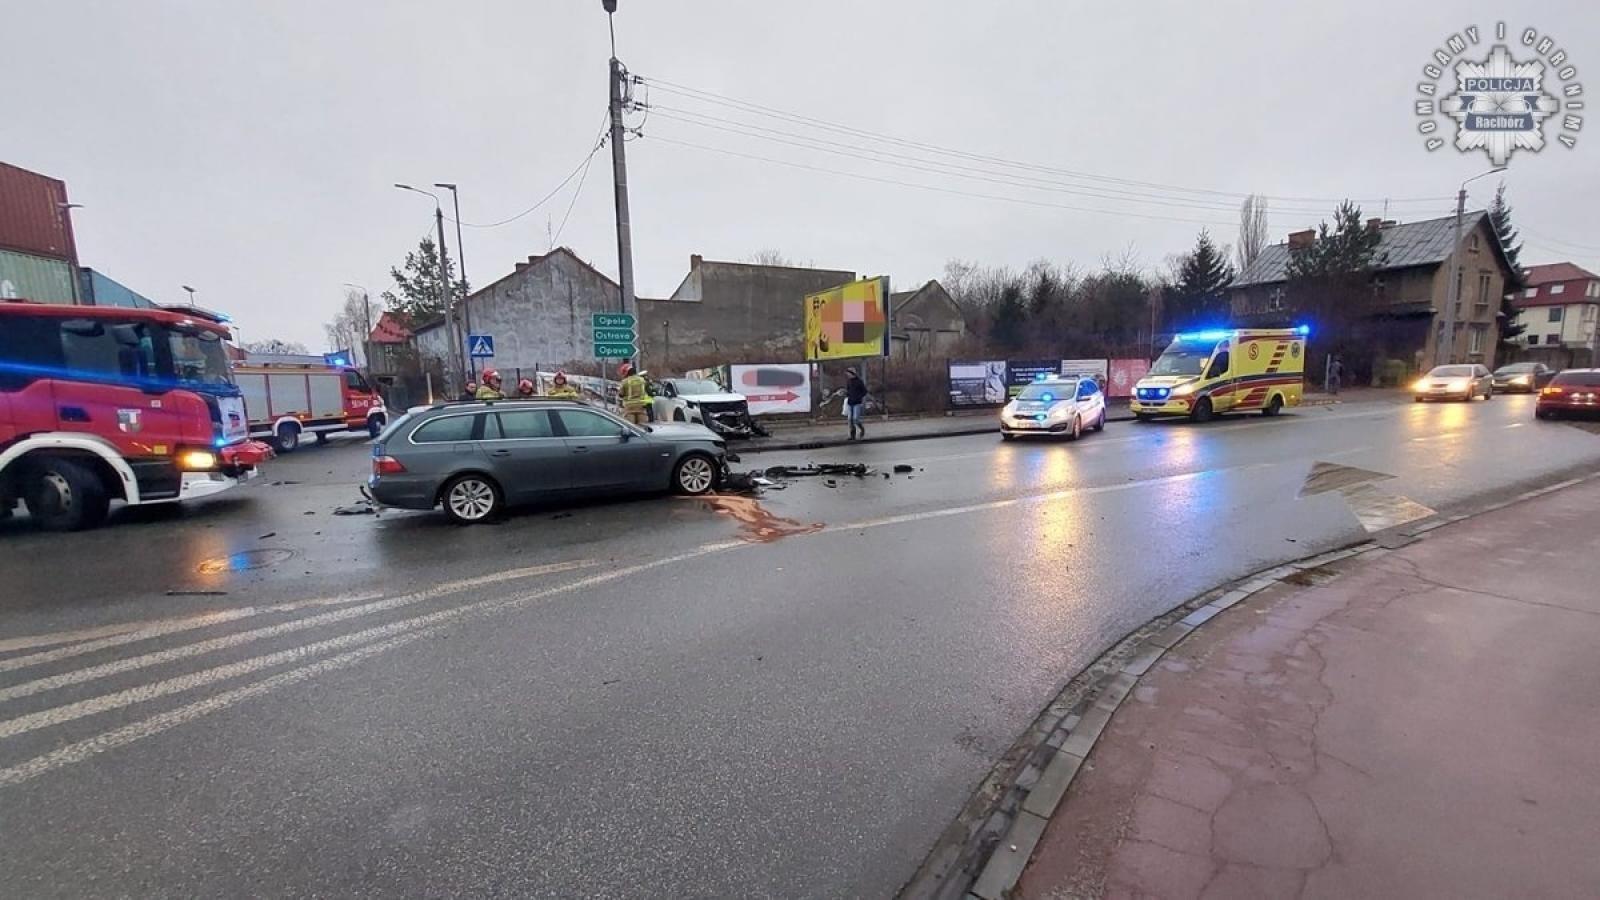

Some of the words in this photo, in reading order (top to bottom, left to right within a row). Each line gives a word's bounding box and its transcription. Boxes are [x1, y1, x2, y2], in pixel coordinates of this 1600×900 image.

[600, 316, 626, 326] Opole
[595, 331, 630, 340] Ostrava
[600, 346, 628, 356] Opava
